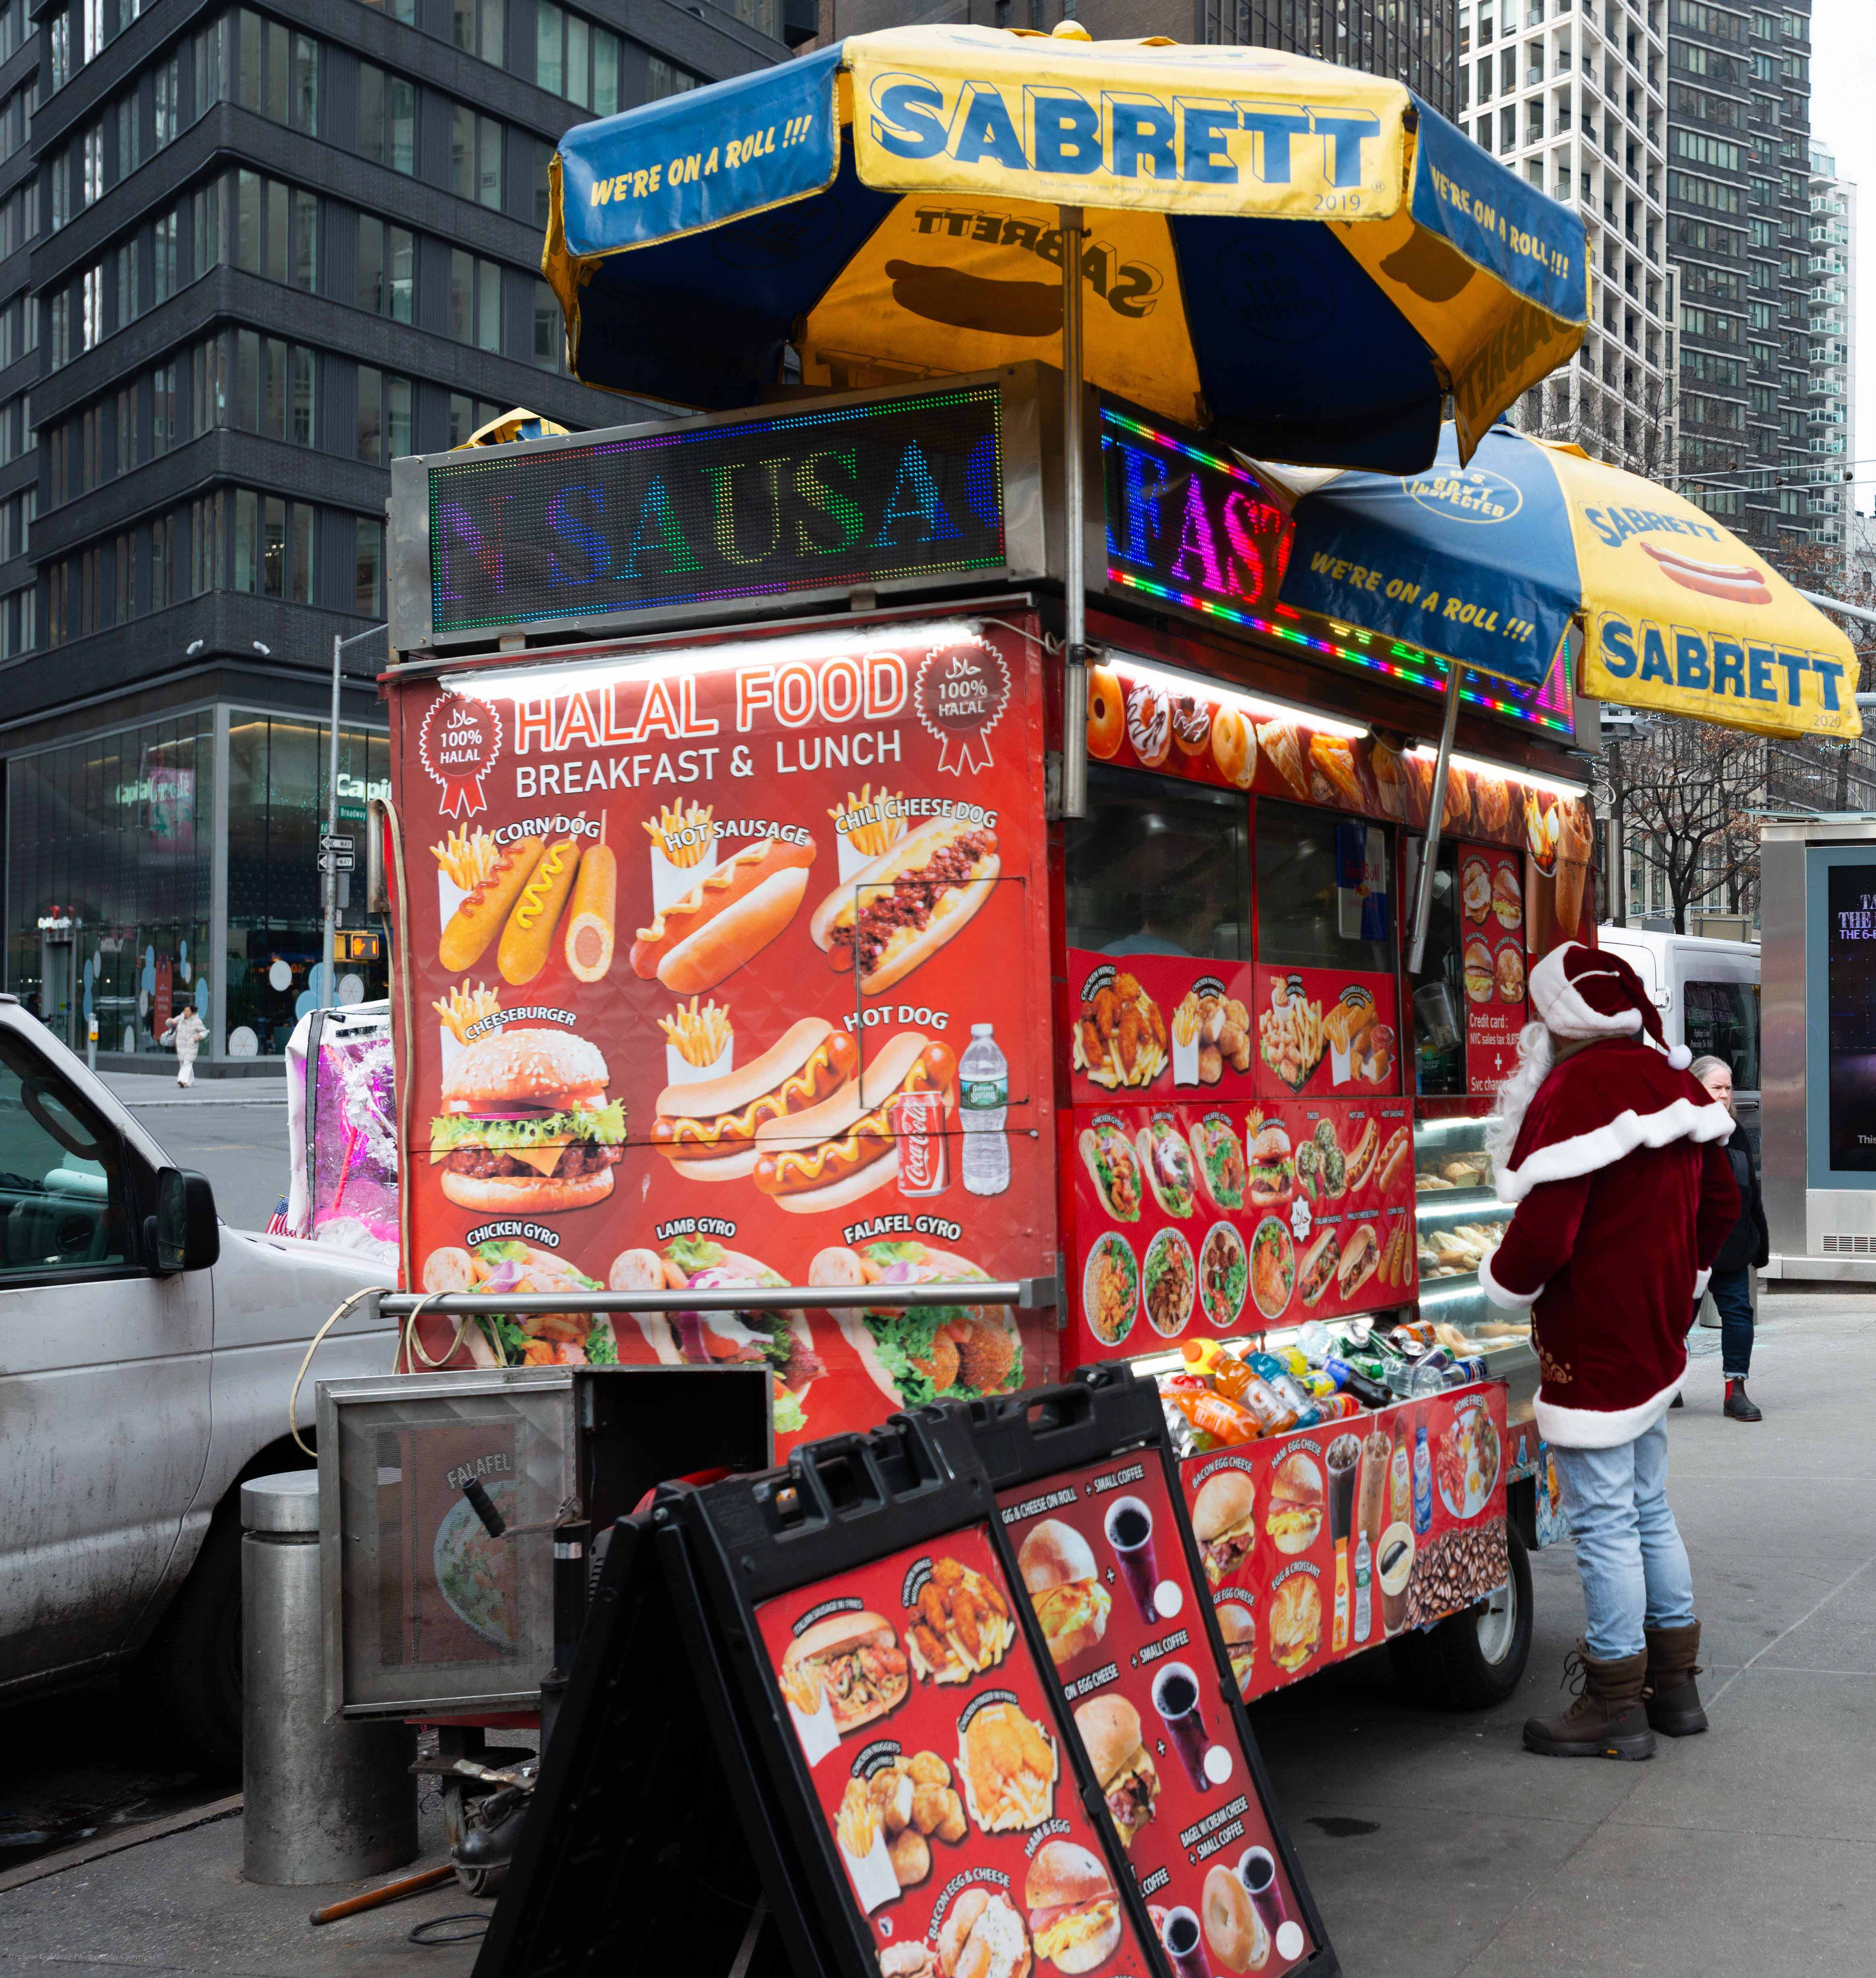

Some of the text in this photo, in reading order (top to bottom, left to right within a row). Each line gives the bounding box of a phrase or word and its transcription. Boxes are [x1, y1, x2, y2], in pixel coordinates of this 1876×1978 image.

[870, 72, 1380, 188] SABRETT
[591, 114, 812, 207] WE'RE ON A ROLL !!!
[1313, 193, 1361, 212] 2019
[1473, 199, 1495, 232] ON
[1498, 216, 1506, 242] A
[1509, 224, 1548, 267] ROLL
[1409, 480, 1505, 518] INSPECTED
[1578, 500, 1721, 548] SABRETT
[1310, 551, 1535, 642] WE'RE ON A ROLL !!!
[945, 656, 982, 679] حلال
[1598, 611, 1845, 711] SABRETT
[938, 679, 988, 700] 100%
[514, 652, 908, 755] HALAL FOOD
[938, 700, 986, 717] HALAL
[447, 708, 478, 729] حلال
[1813, 714, 1841, 728] 2020
[441, 729, 483, 747] 100%
[440, 748, 481, 764] HALAL
[516, 729, 902, 799] BREAKFAST & LUNCH
[341, 808, 366, 821] Broadway
[834, 798, 998, 834] CHILI CHEESE DOG
[494, 815, 601, 845] CORN DOG
[664, 819, 810, 852] HOT SAUSAGE
[1363, 863, 1379, 882] Bull
[1838, 912, 1871, 928] THE
[1839, 930, 1860, 939] THE
[1081, 966, 1115, 1000] CHICKEN WINGS
[1088, 977, 1111, 1001] WITH FRIES
[1192, 977, 1225, 993] CHICKEN NUGGETS
[1199, 988, 1219, 998] WITH FRIES
[465, 1006, 577, 1041] CHEESEBURGER
[843, 1005, 949, 1032] HOT DOG
[1470, 1013, 1504, 1028] Credit card
[1470, 1032, 1505, 1045] NYC sales tax
[1471, 1077, 1483, 1091] Svc
[1092, 1114, 1124, 1130] CHICKEN GYRO
[1151, 1112, 1174, 1123] LAMB GYRO
[1203, 1112, 1233, 1127] FALAFEL GYRO
[1256, 1118, 1285, 1134] CHEESEBURGER
[1306, 1111, 1319, 1120] TACOS
[1857, 1134, 1876, 1144] This
[466, 1221, 560, 1248] CHICKEN GYRO
[655, 1217, 736, 1240] LAMB GYRO
[843, 1215, 962, 1244] FALAFEL GYRO
[1454, 1394, 1484, 1416] HOME FRIES
[1271, 1438, 1322, 1469] HAM EGG CHEESE
[447, 1453, 511, 1490] FALAFEL
[1192, 1455, 1253, 1489] BACON EGG CHEESE
[1002, 1463, 1145, 1524] GG & CHEESE ON ROLL SMALL COFFEE
[912, 1557, 931, 1574] WINGS
[1271, 1560, 1321, 1591] EGG & CROISSANT
[1221, 1588, 1233, 1602] EGG
[1234, 1586, 1255, 1607] CHEESE
[1139, 1628, 1189, 1664] SMALL COFFEE
[1077, 1676, 1092, 1695] EGG
[1091, 1663, 1119, 1686] CHEESE
[852, 1748, 872, 1777] CHICKEN
[1180, 1795, 1249, 1848] BAGEL CHEESE
[1024, 1818, 1071, 1858] HAM & EGG
[1197, 1820, 1245, 1860] SMALL COFFEE
[1143, 1866, 1170, 1893] COFFEE
[929, 1867, 1011, 1940] BACON EGG & CHEESE
